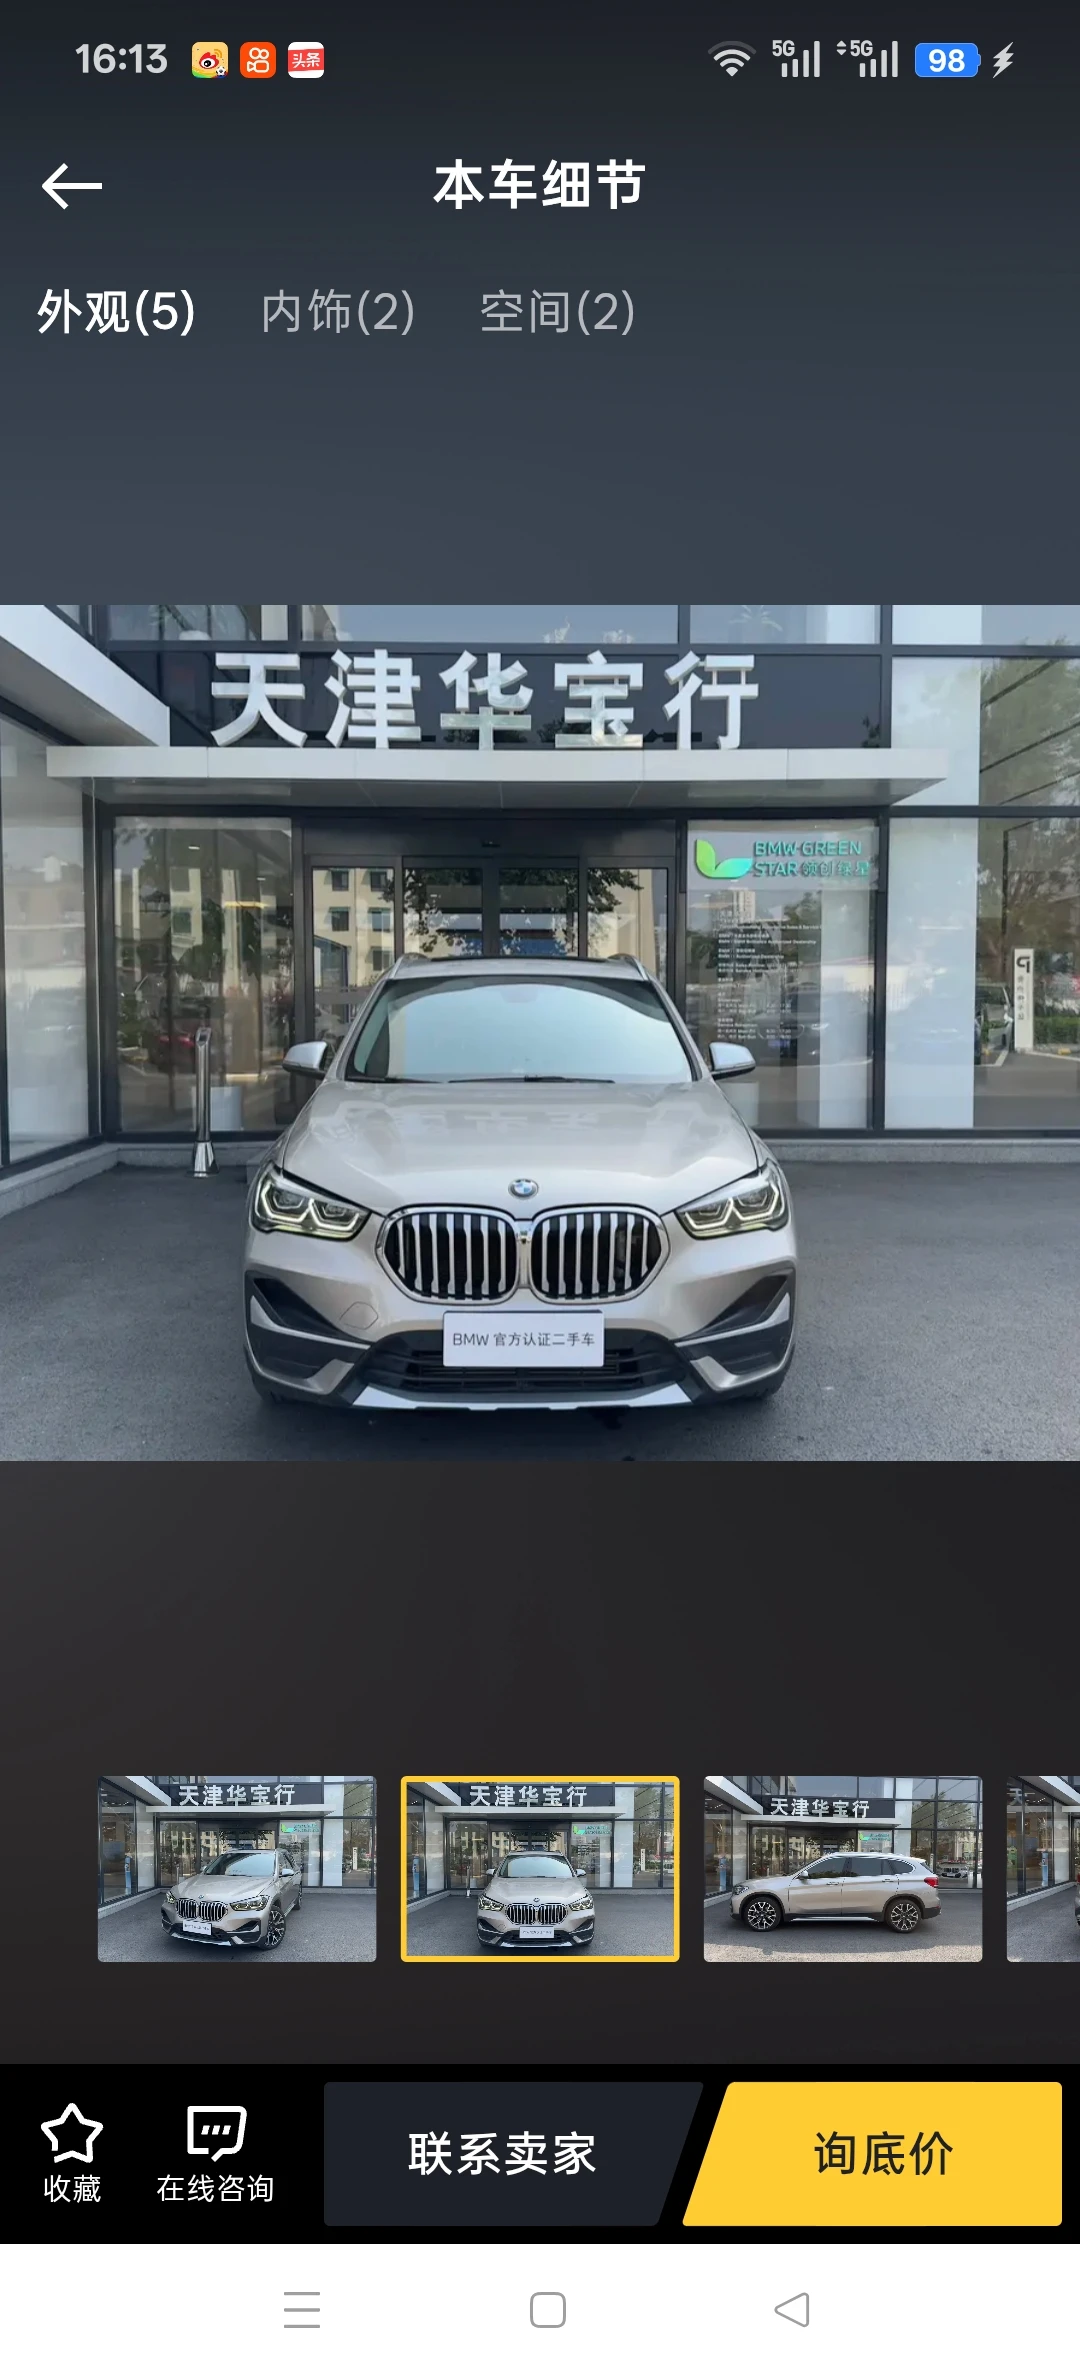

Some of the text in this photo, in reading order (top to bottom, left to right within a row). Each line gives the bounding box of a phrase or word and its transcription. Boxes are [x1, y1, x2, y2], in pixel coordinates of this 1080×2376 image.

[75, 43, 168, 74] 16:13
[291, 52, 321, 69] 头条
[772, 40, 796, 57] 5G
[850, 40, 874, 57] 5G
[928, 48, 966, 73] 98
[433, 158, 646, 210] 本车细节
[36, 288, 195, 337] 外观(5)
[263, 288, 414, 336] 内饰(2)
[480, 288, 634, 336] 空间(2)
[210, 649, 759, 750] 天津华宝行
[753, 841, 862, 857] BMW GREEN
[753, 860, 798, 877] STAR
[452, 1331, 596, 1347] BMW 官方认证二手车
[178, 1783, 297, 1807] 天津华宝行
[468, 1785, 589, 1808] 天津华宝行
[770, 1797, 870, 1818] 天津华宝行
[407, 2130, 597, 2176] 联系卖家
[814, 2130, 954, 2176] 询底价
[43, 2174, 102, 2204] 收藏
[156, 2173, 274, 2203] 在线咨询
